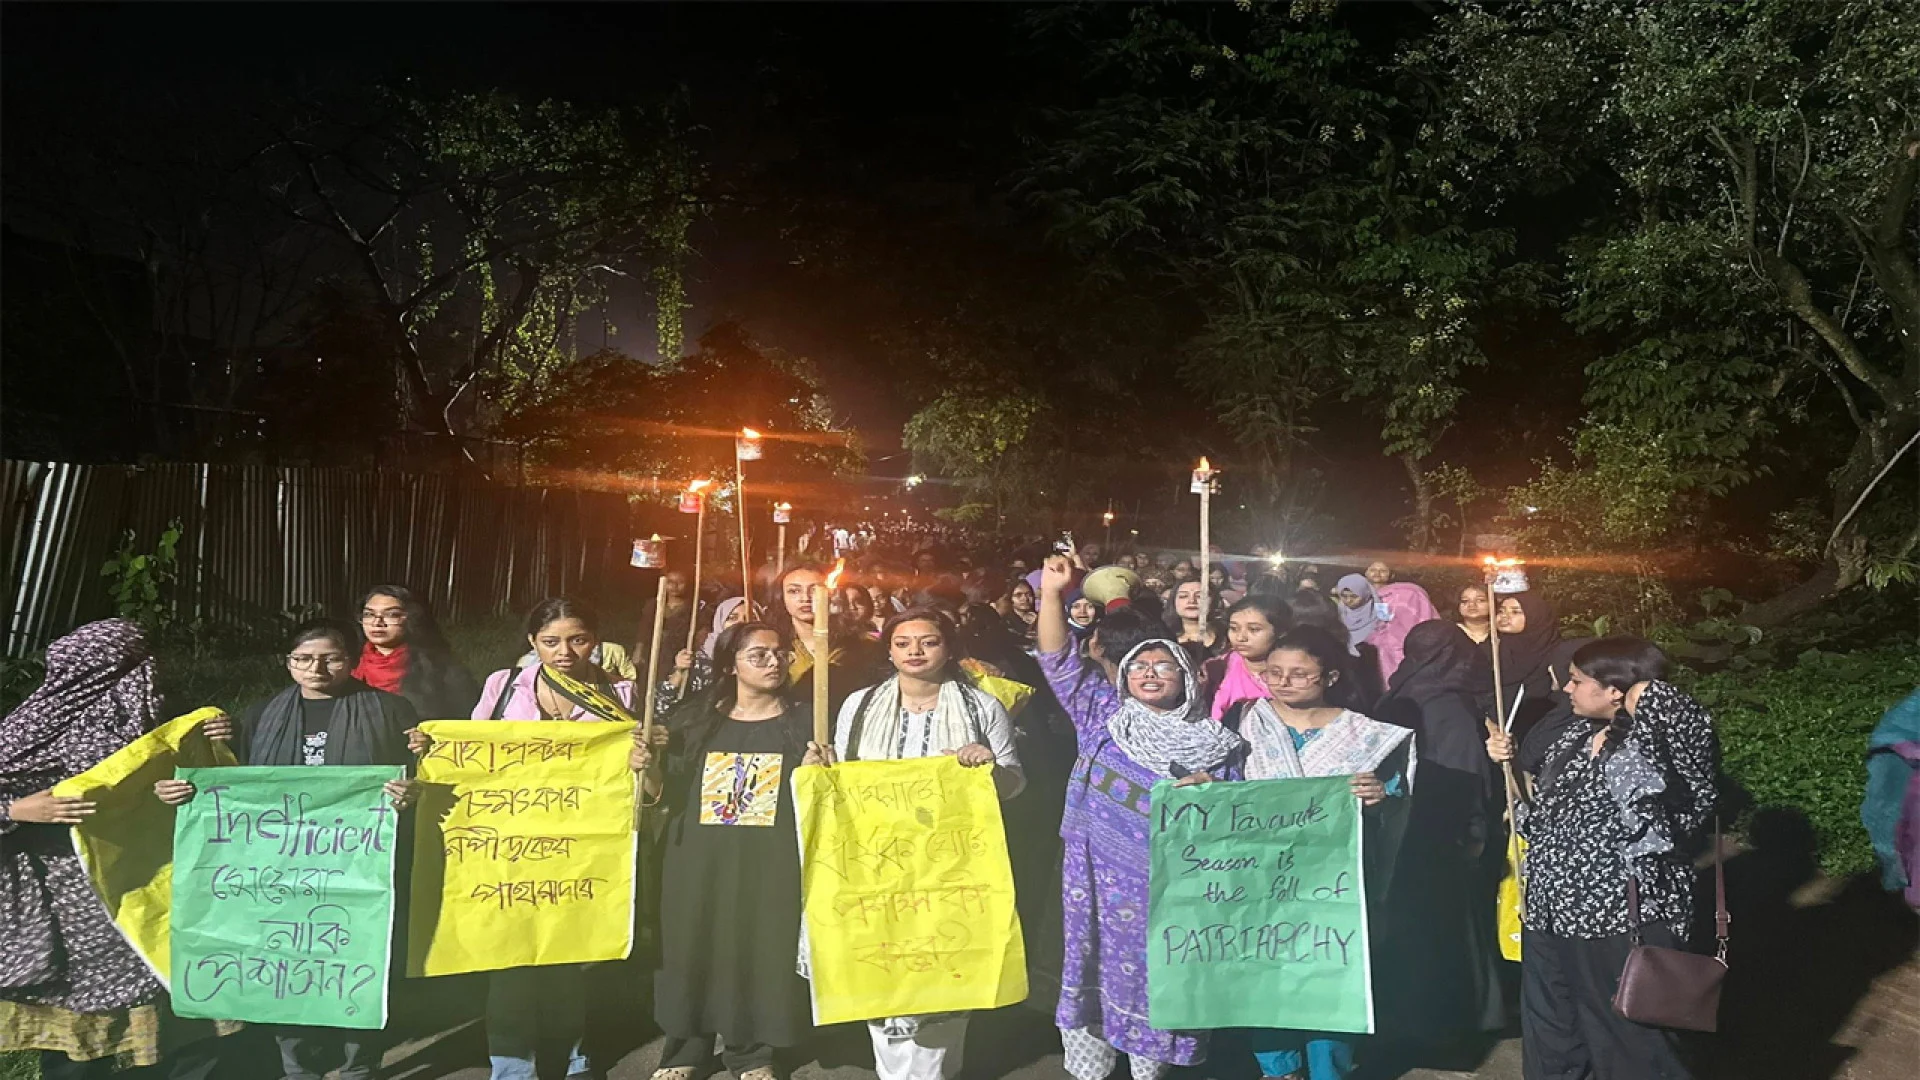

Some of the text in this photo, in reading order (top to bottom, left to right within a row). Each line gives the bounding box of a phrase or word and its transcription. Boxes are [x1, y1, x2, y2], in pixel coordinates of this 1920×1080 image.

[461, 786, 592, 819] চমৎকার
[1160, 804, 1215, 832] MY
[203, 785, 391, 857] Inefficient
[1181, 844, 1294, 875] Season is
[1203, 881, 1249, 904] the
[1312, 871, 1351, 901] of
[258, 904, 352, 955] নাকি
